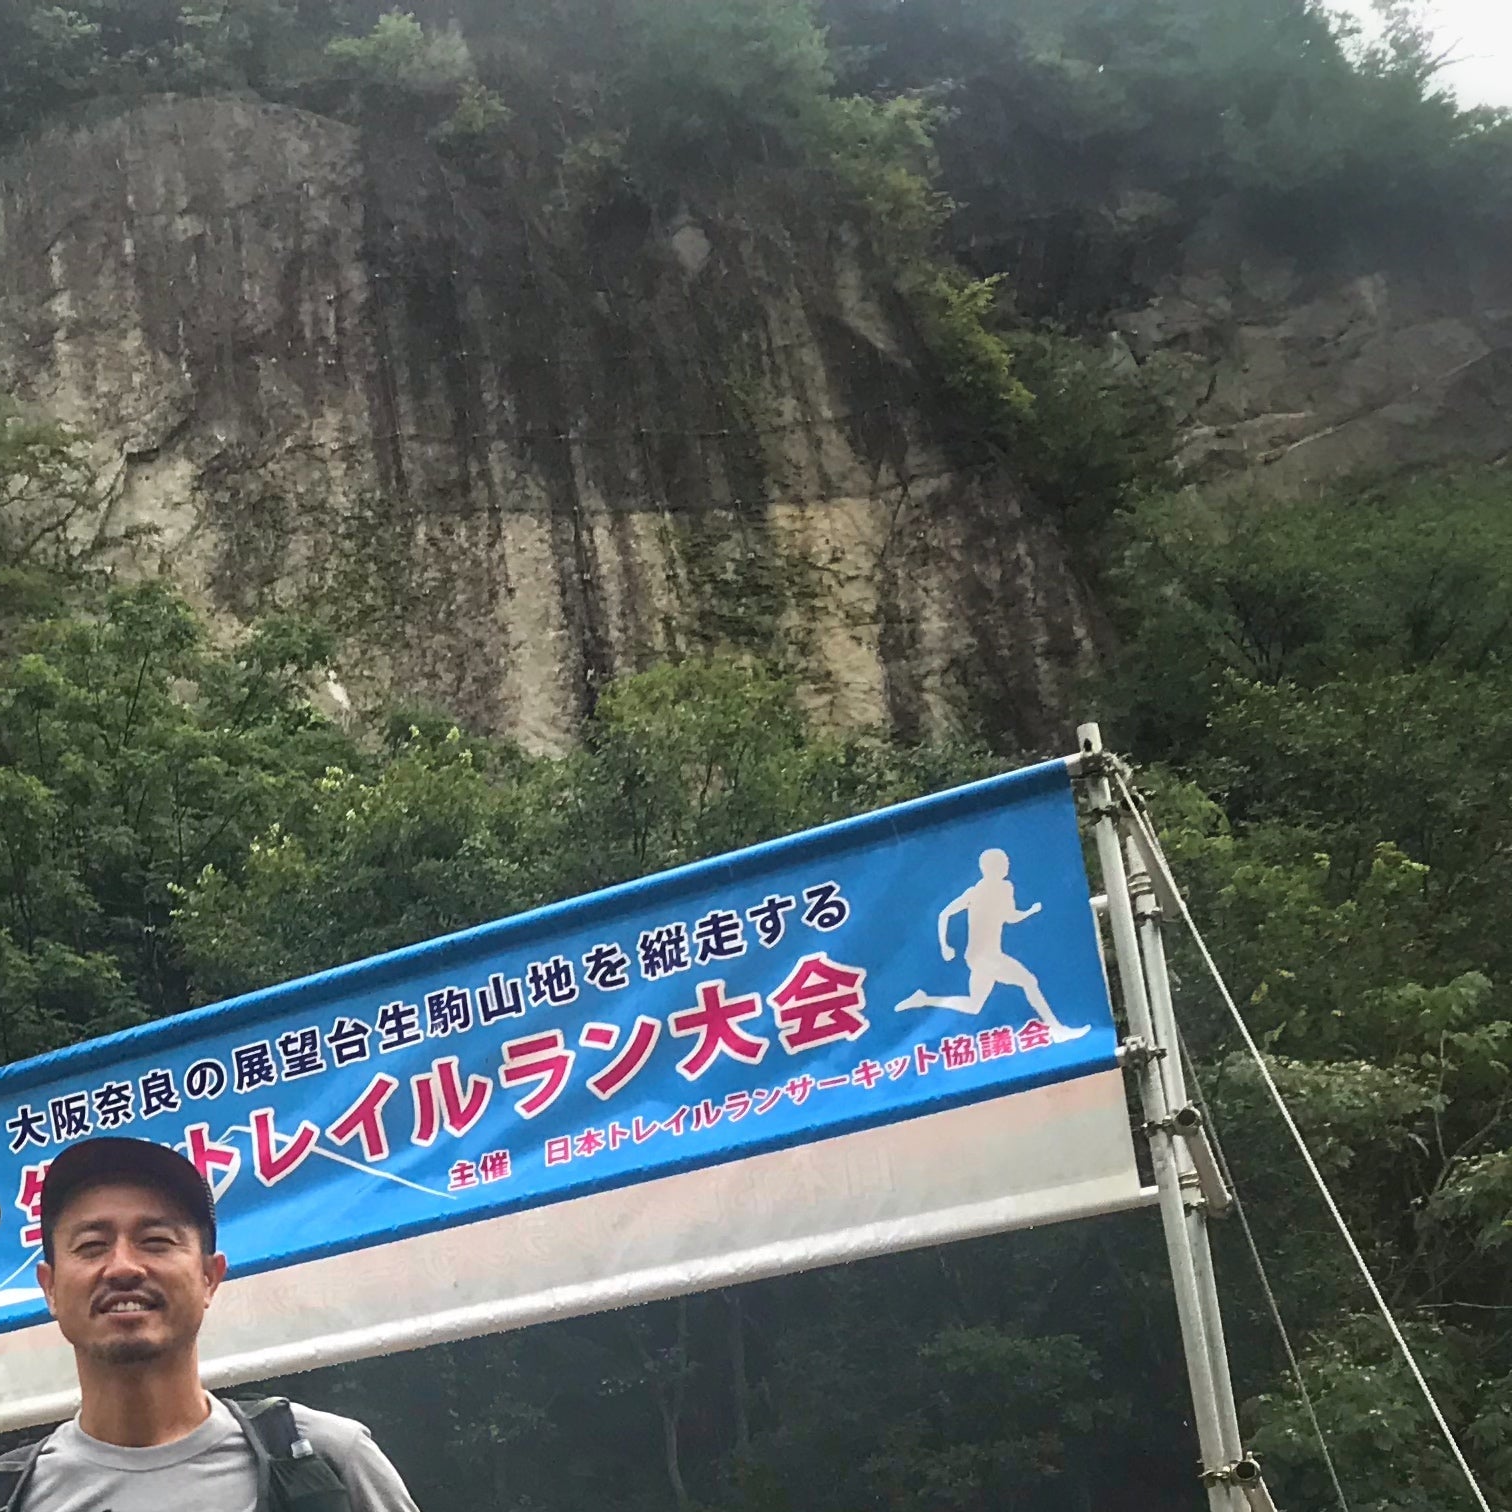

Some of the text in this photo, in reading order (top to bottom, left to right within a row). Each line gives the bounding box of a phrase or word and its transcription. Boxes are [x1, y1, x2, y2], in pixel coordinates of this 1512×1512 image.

[7, 880, 850, 1153] 大阪奈良の展望台生駒山地を縦走する
[18, 952, 870, 1247] トレイルラン大会
[448, 1020, 1053, 1190] 主催 日本トレイルランサーキット協議会
